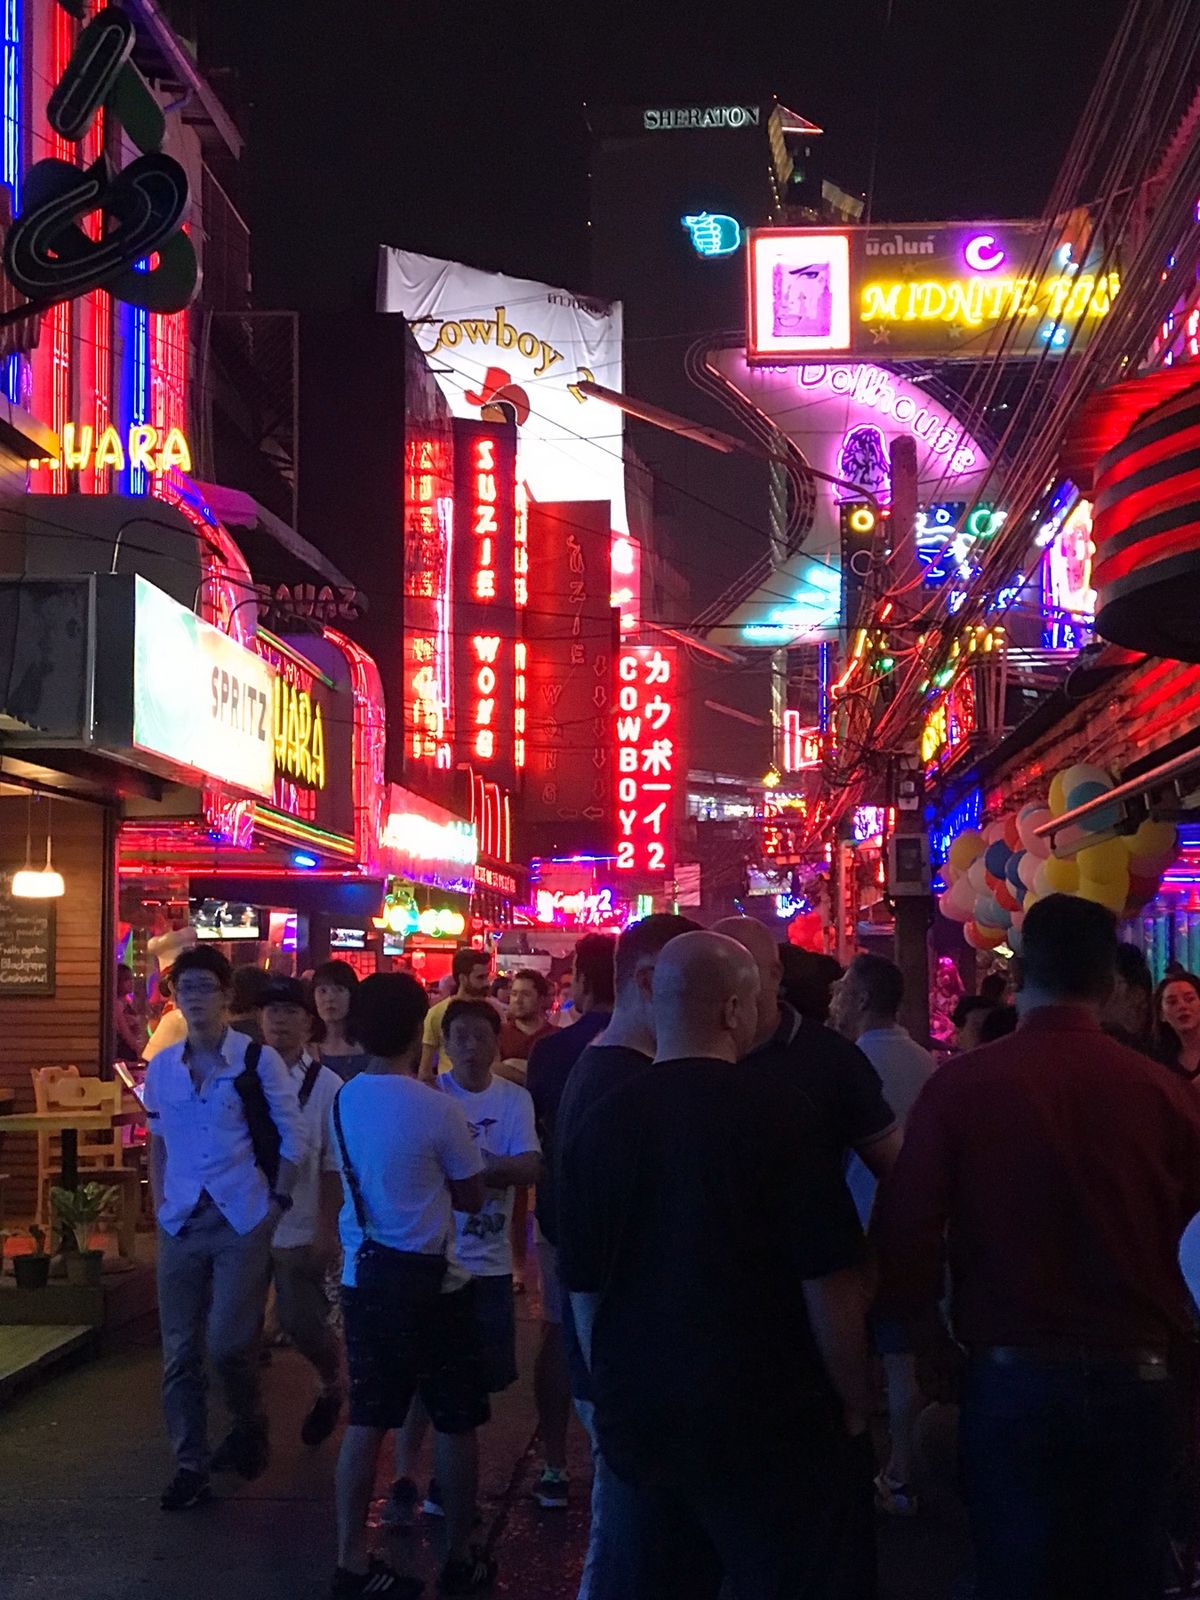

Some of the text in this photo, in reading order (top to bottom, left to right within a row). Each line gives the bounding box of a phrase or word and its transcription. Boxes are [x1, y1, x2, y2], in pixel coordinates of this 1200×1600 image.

[644, 106, 760, 130] SHERATON
[412, 306, 564, 376] Cowboy
[473, 440, 500, 759] SUZIE WONG
[211, 665, 267, 742] SPRITZ
